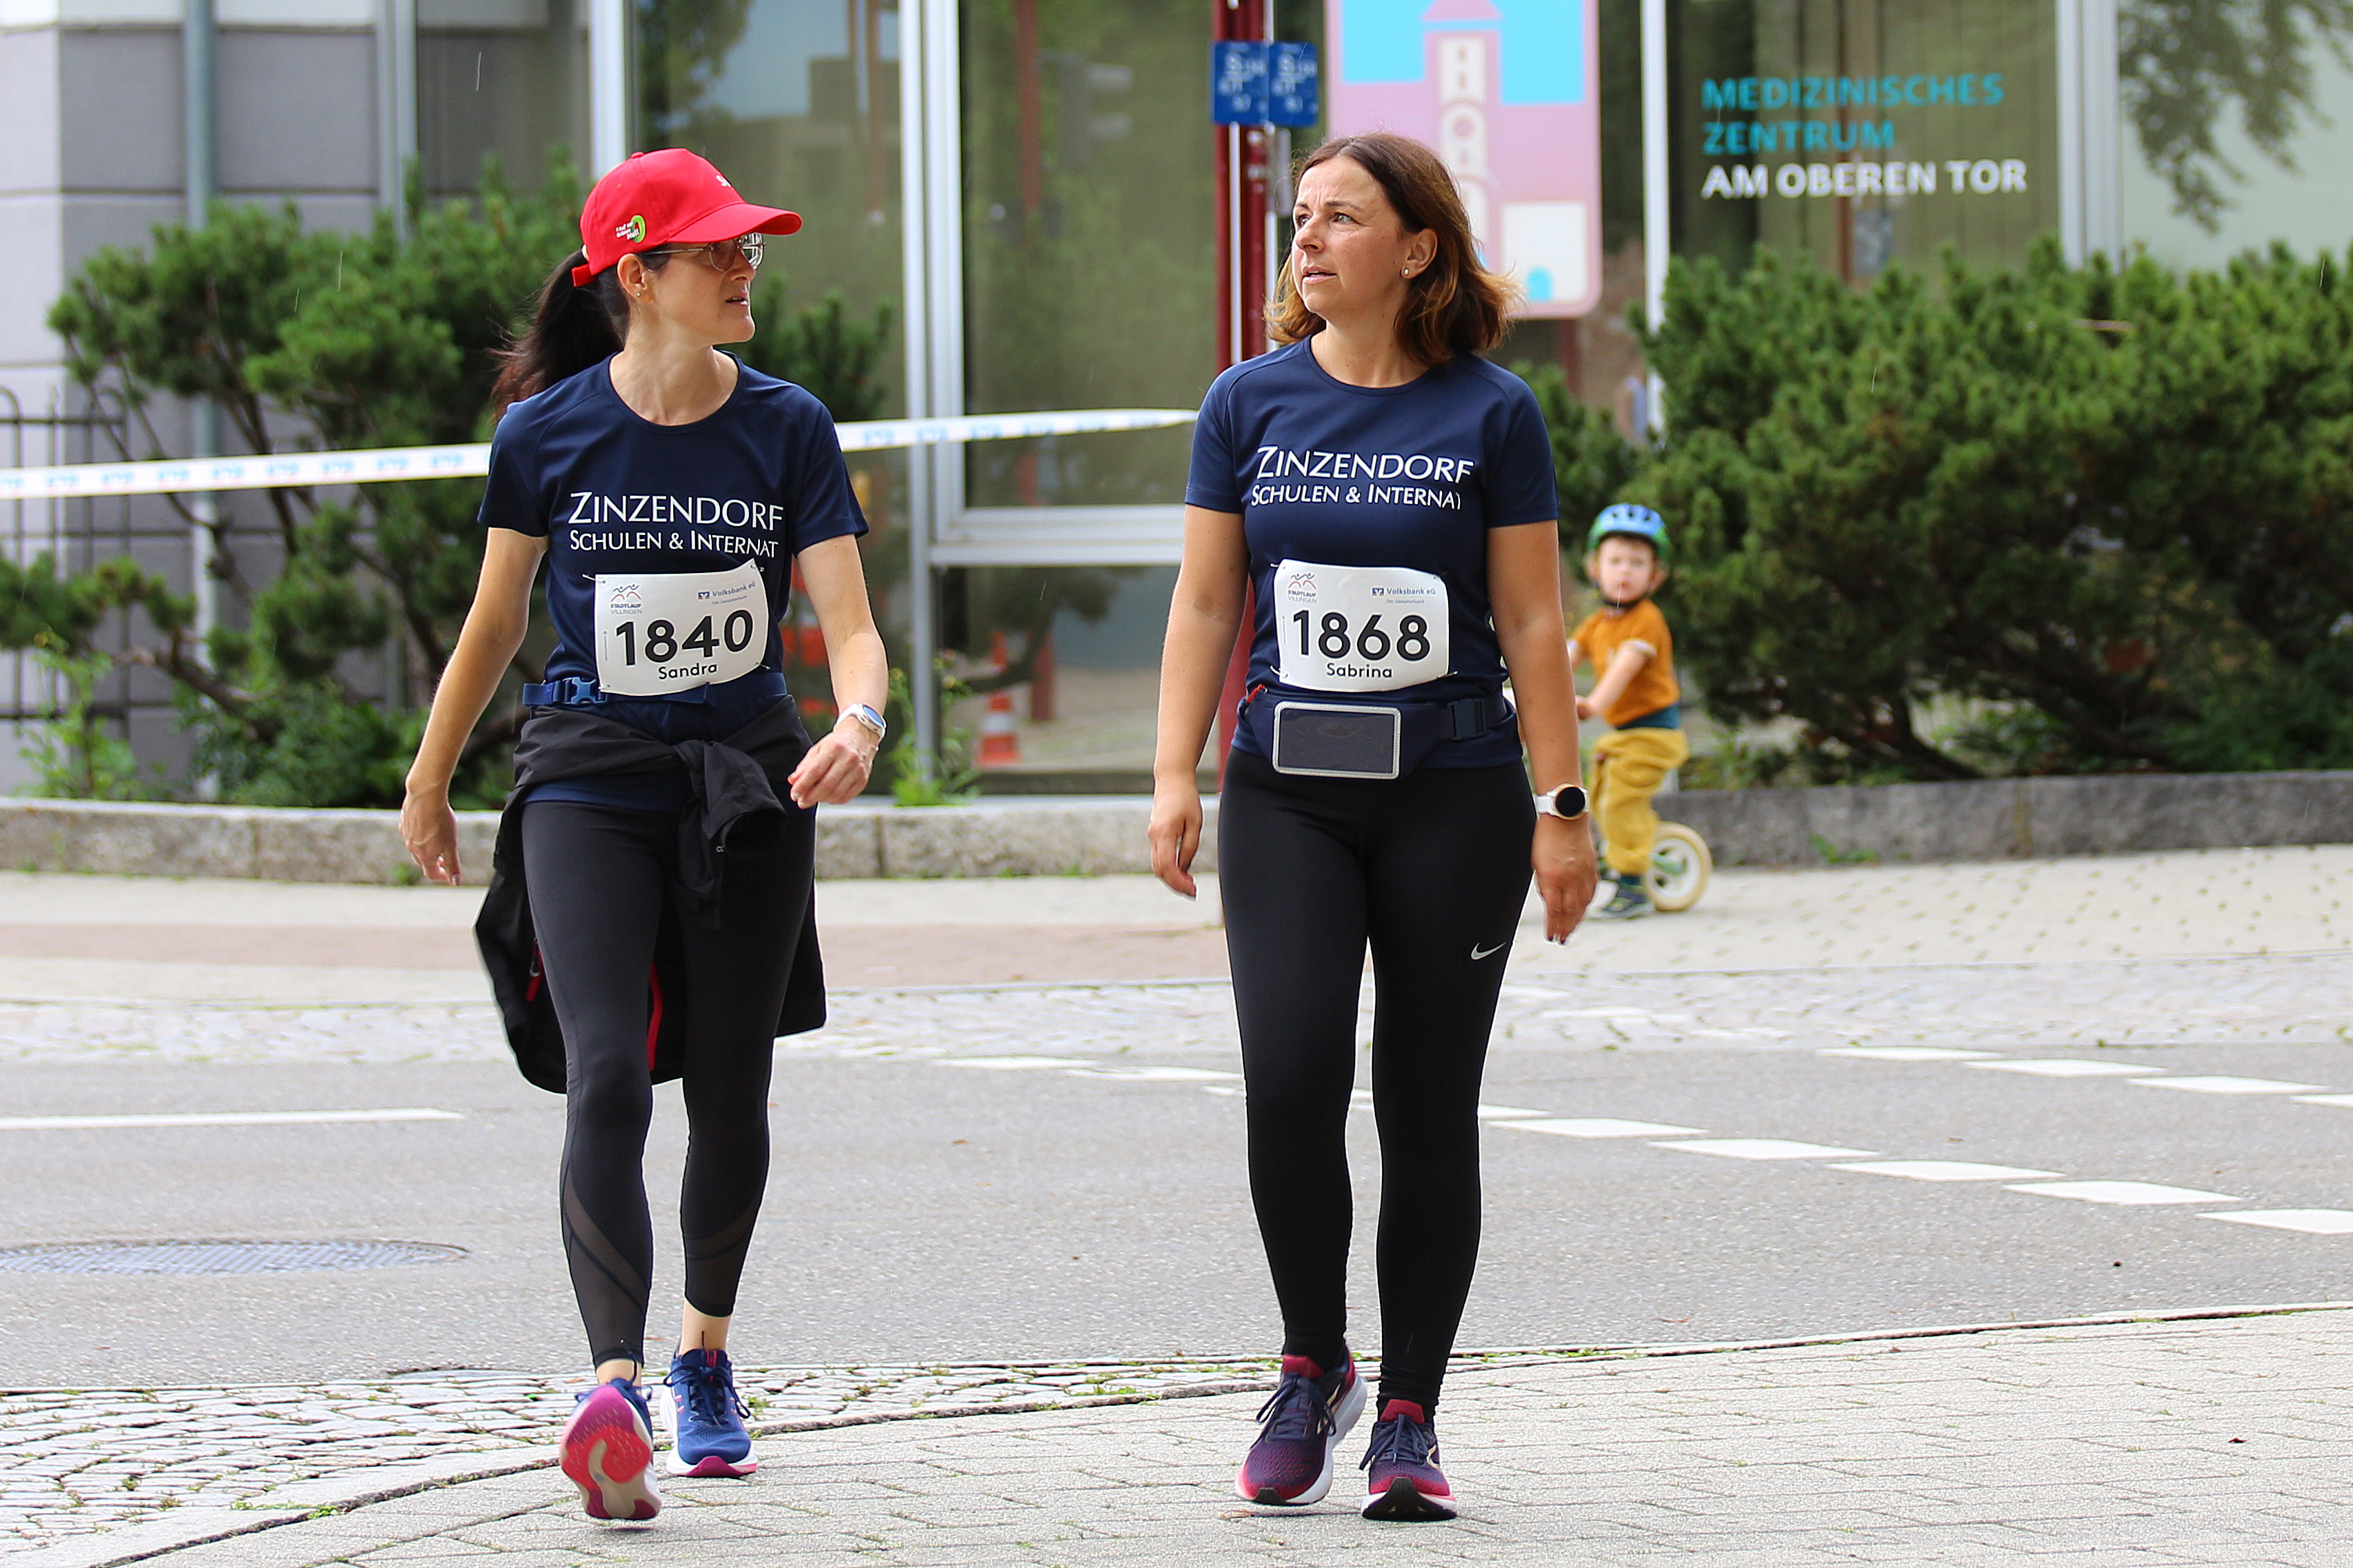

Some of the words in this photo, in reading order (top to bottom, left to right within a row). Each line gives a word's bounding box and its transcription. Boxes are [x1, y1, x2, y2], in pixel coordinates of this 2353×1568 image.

[1701, 73, 2005, 110] MEDIZINISCHES
[1701, 119, 1895, 155] ZENTRUM
[1701, 163, 1769, 199] AM
[1775, 161, 1936, 198] OBEREN
[1944, 158, 2027, 194] TOR
[1256, 445, 1474, 483] ZINZENDORF
[568, 492, 784, 531] ZINZENDORF
[1251, 484, 1340, 507] SCHULEN
[1345, 486, 1361, 504] &
[570, 530, 662, 551] SCHULEN
[668, 532, 684, 550] &
[691, 530, 779, 559] INTERNAT
[712, 585, 748, 597] Volksbank
[616, 610, 754, 666] 1840
[1293, 610, 1430, 661] 1868
[658, 663, 718, 680] Sandra
[1326, 663, 1392, 679] Sabrina
